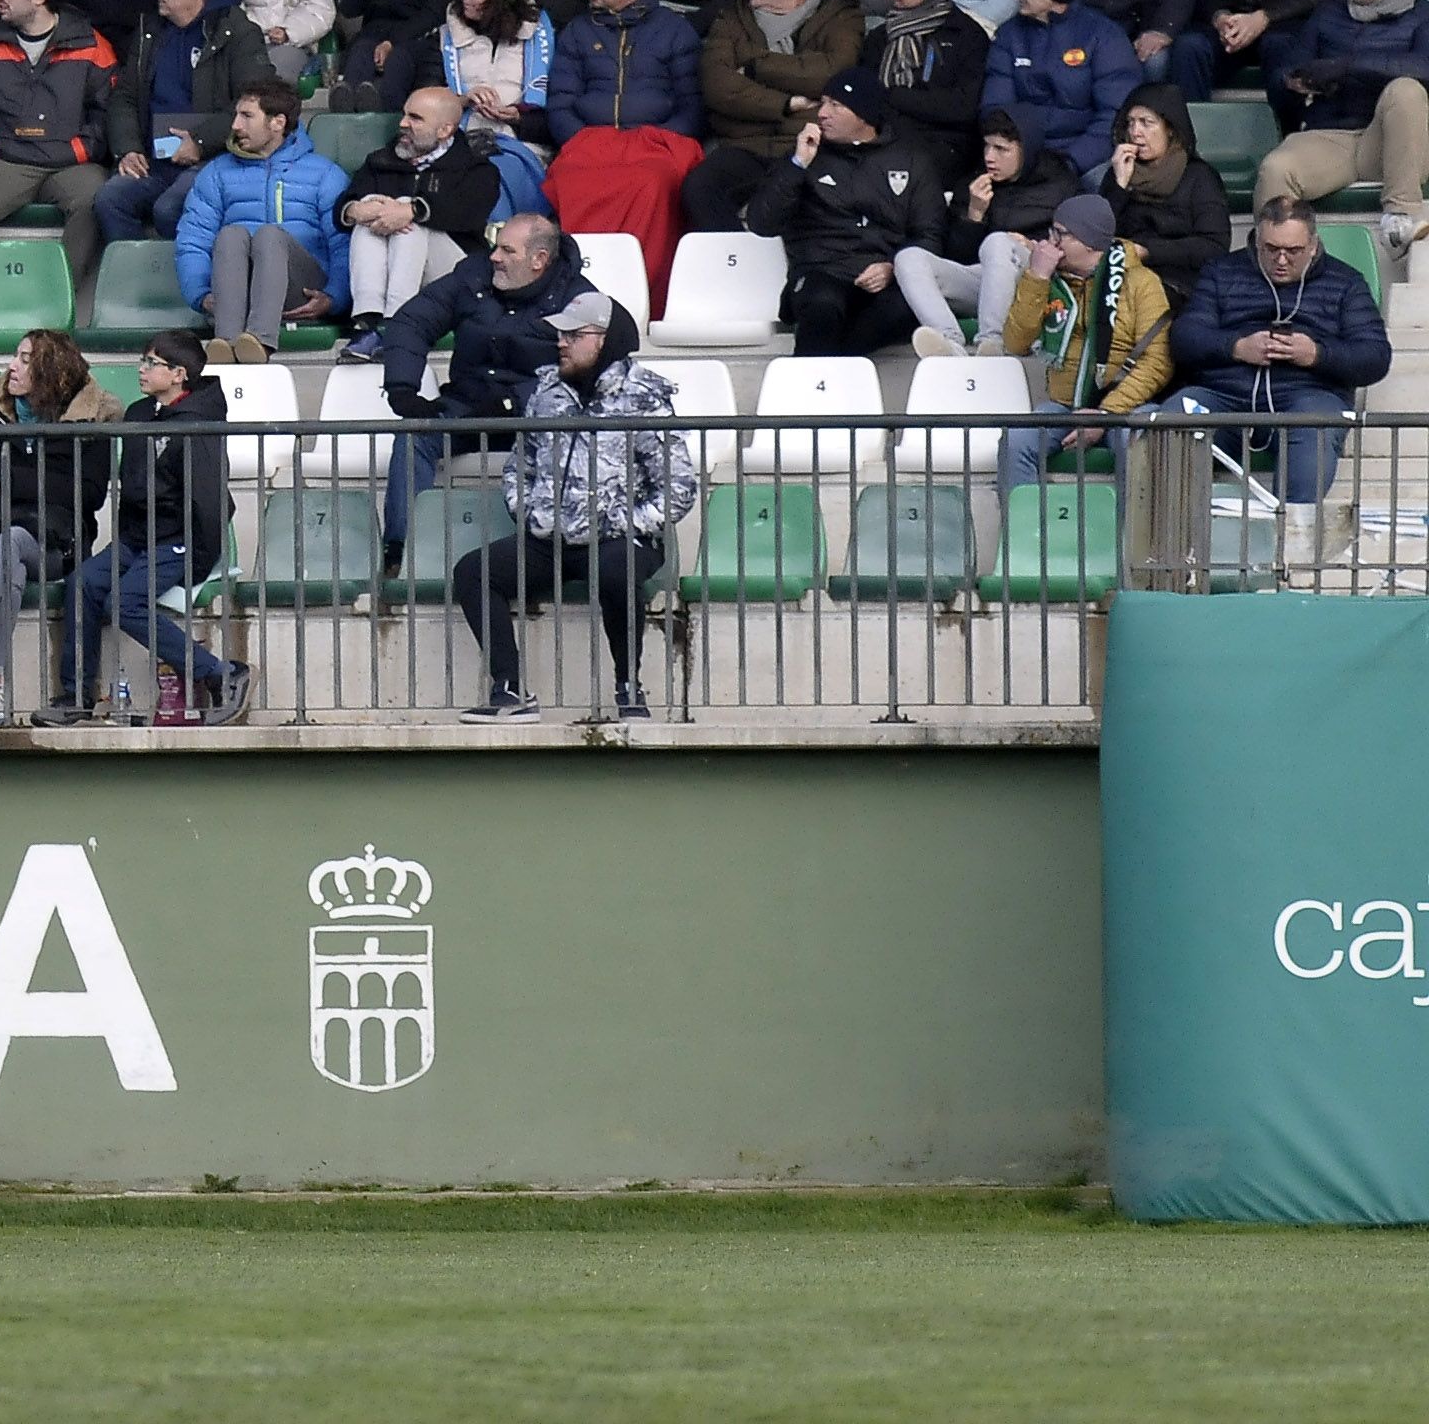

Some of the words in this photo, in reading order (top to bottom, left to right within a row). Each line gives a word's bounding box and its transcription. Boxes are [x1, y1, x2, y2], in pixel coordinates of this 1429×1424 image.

[727, 254, 738, 267] 5
[5, 262, 24, 275] 10
[815, 380, 826, 392] 4
[966, 378, 976, 392] 3
[234, 387, 244, 400] 8
[316, 512, 327, 526] 7
[462, 511, 473, 525] 6
[755, 507, 766, 521] 4
[908, 507, 919, 521] 3
[1058, 506, 1069, 520] 2
